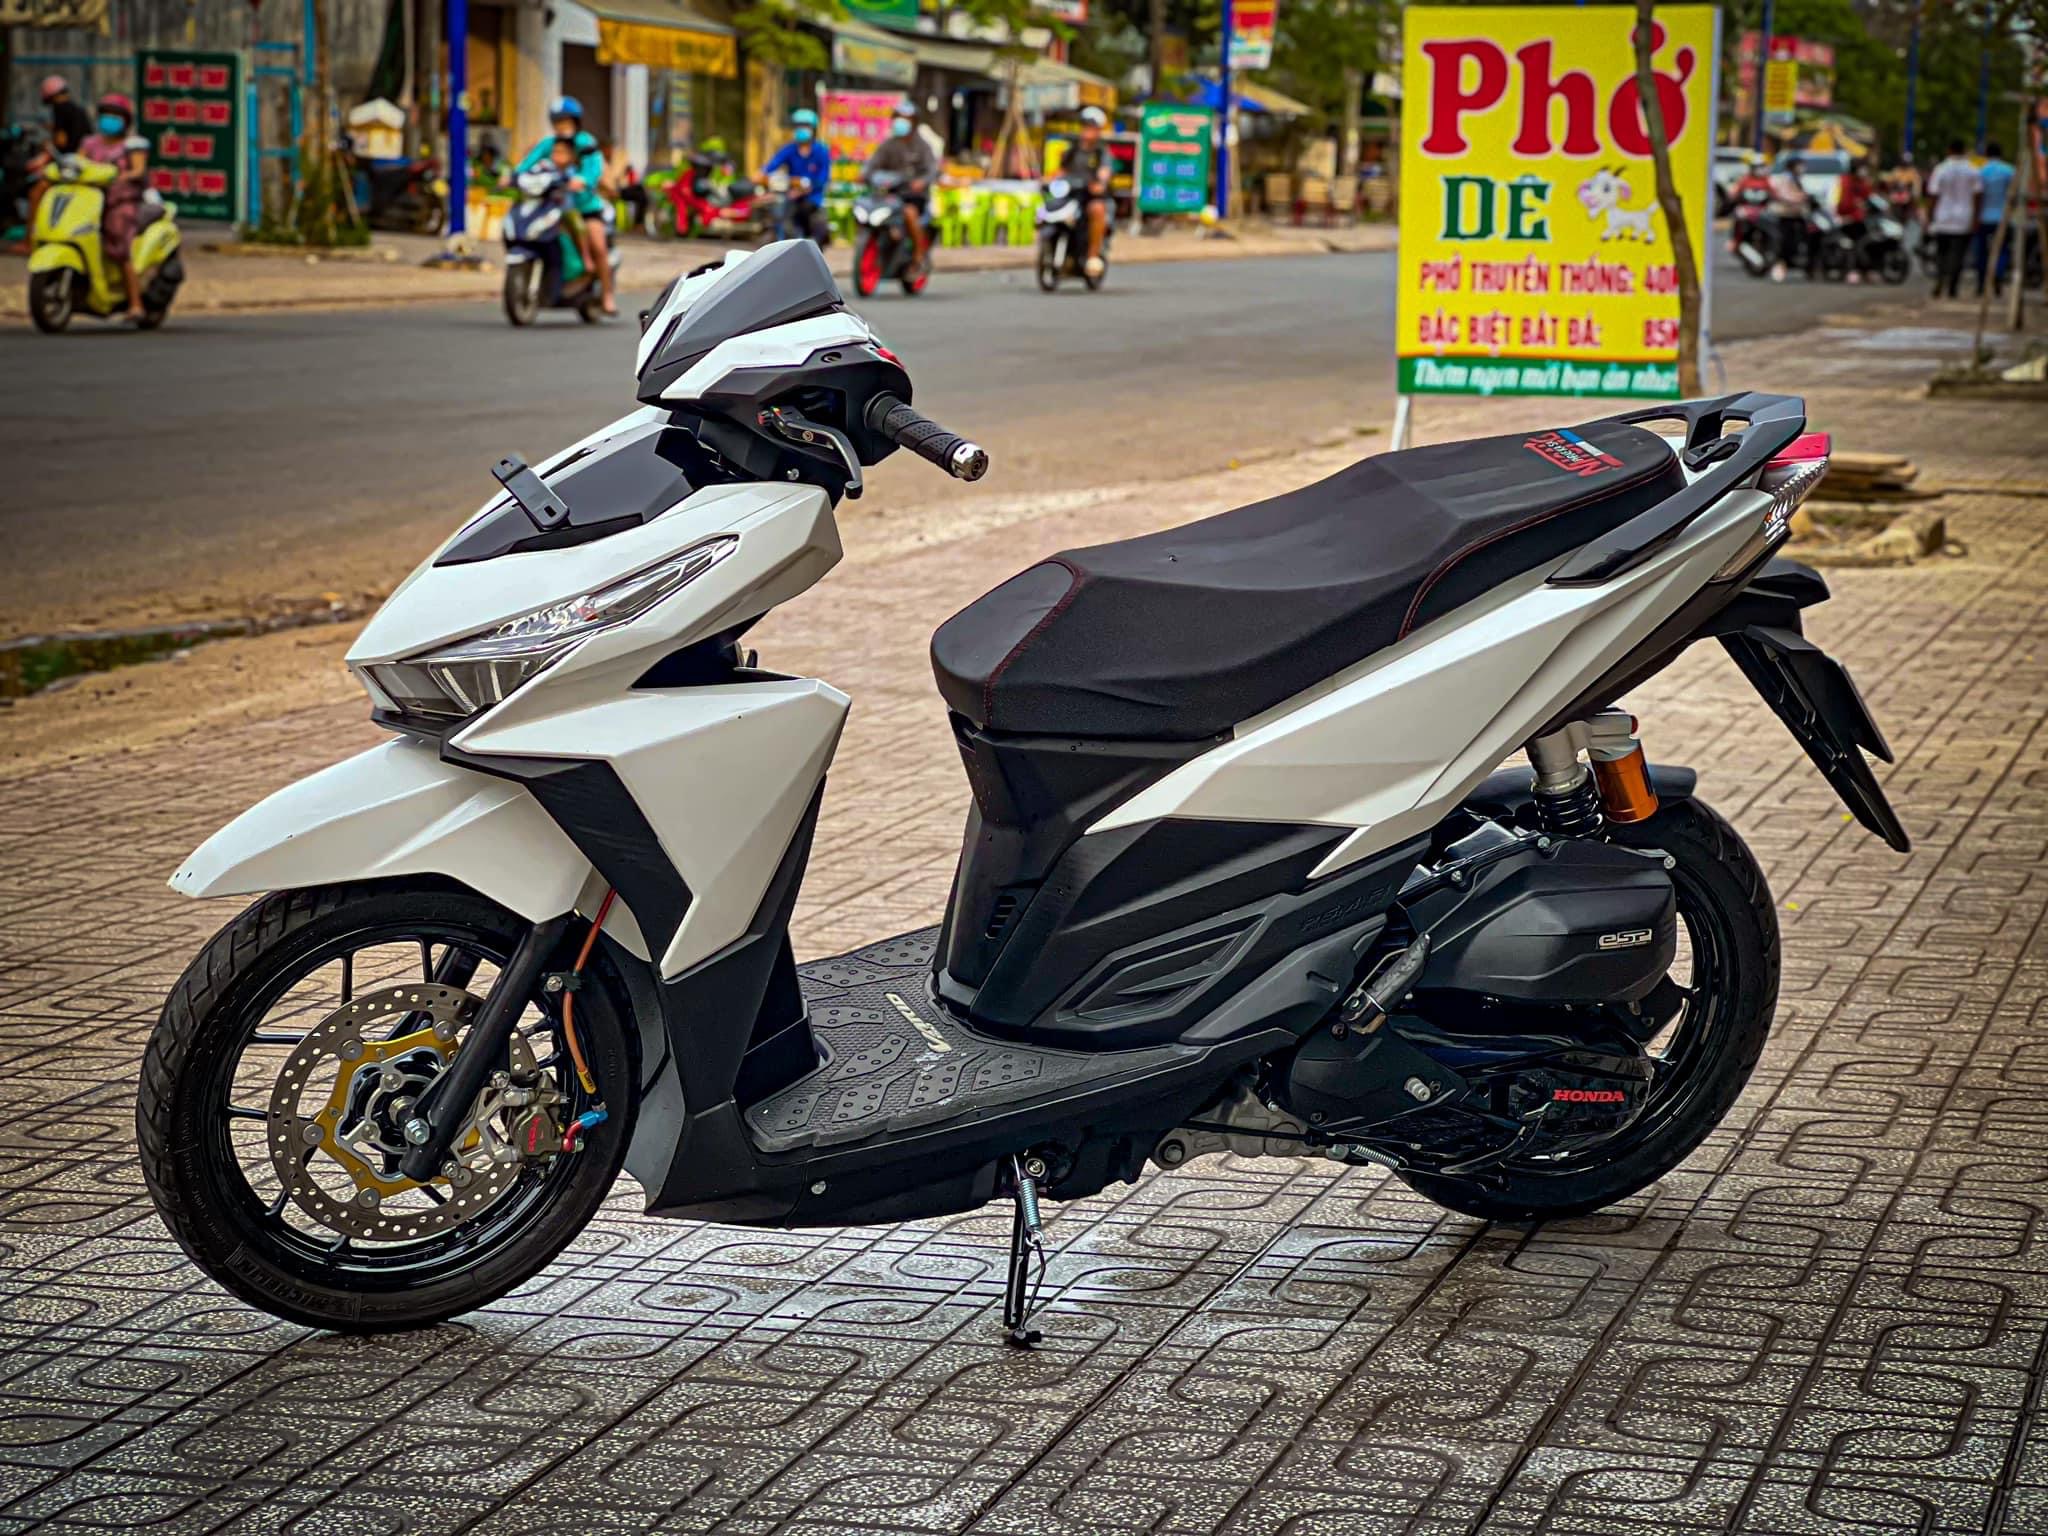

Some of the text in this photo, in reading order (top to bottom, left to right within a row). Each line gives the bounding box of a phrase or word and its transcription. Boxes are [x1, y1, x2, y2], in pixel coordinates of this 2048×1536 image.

[1421, 19, 1695, 156] Phở
[1441, 173, 1551, 240] DÊ
[1552, 1089, 1625, 1102] HONDA
